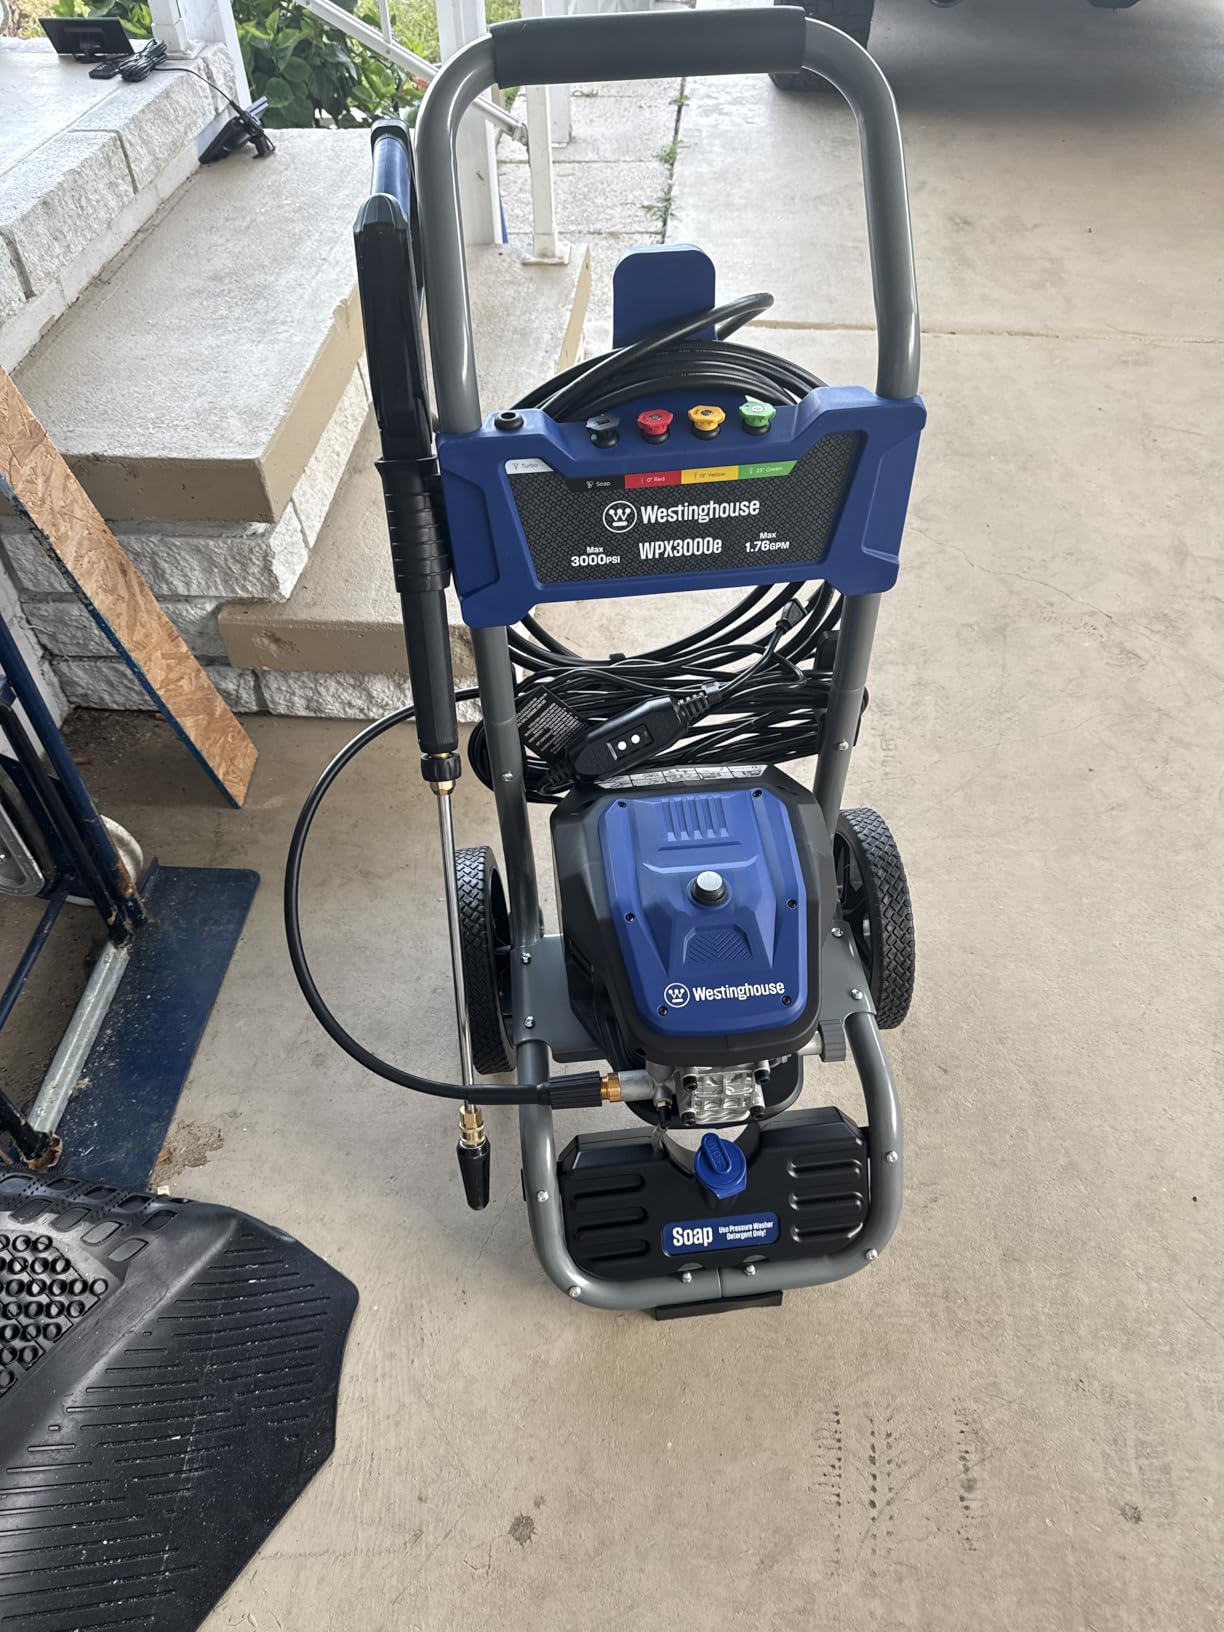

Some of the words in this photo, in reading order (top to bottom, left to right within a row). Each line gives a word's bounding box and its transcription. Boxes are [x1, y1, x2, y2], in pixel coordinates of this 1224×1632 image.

[640, 500, 760, 524] Westinghouse
[638, 537, 723, 560] WPX3000e
[745, 540, 790, 553] 1.76GPM
[571, 554, 620, 567] 3000PSI
[692, 982, 785, 1001] Westinghouse
[718, 1226, 729, 1234] Use
[729, 1224, 753, 1232] Pressure
[752, 1221, 773, 1230] Washer
[726, 1231, 752, 1240] Detergent
[752, 1229, 767, 1237] Only!
[672, 1227, 713, 1247] Soap
